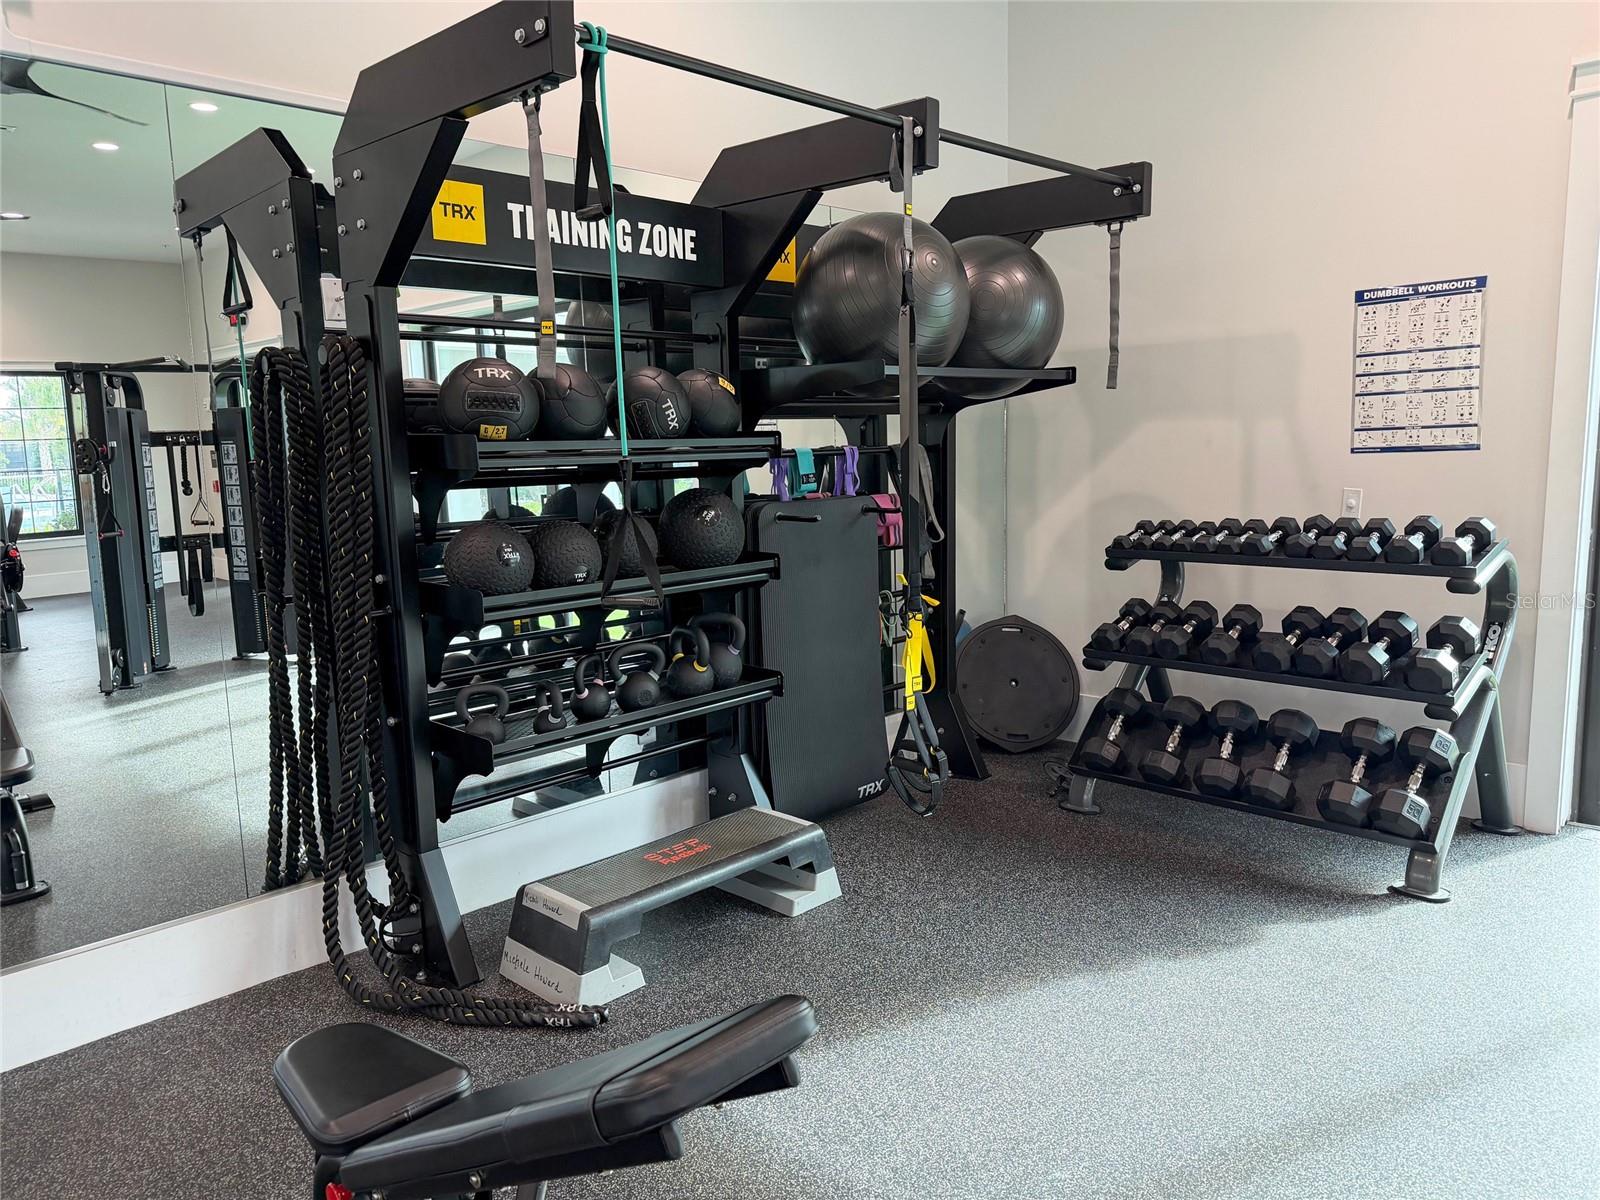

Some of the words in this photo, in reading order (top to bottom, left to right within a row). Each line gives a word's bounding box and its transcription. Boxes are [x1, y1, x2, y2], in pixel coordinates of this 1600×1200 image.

[439, 201, 476, 221] TRX
[637, 221, 697, 261] ZONE
[1363, 286, 1415, 300] DUMBBELL
[1418, 279, 1477, 293] WORKOUTS
[473, 367, 513, 381] TRX
[661, 398, 679, 430] TRX
[857, 778, 885, 799] TRX
[643, 838, 699, 861] STEP
[534, 966, 563, 994] Howard
[544, 1017, 573, 1028] TRX
